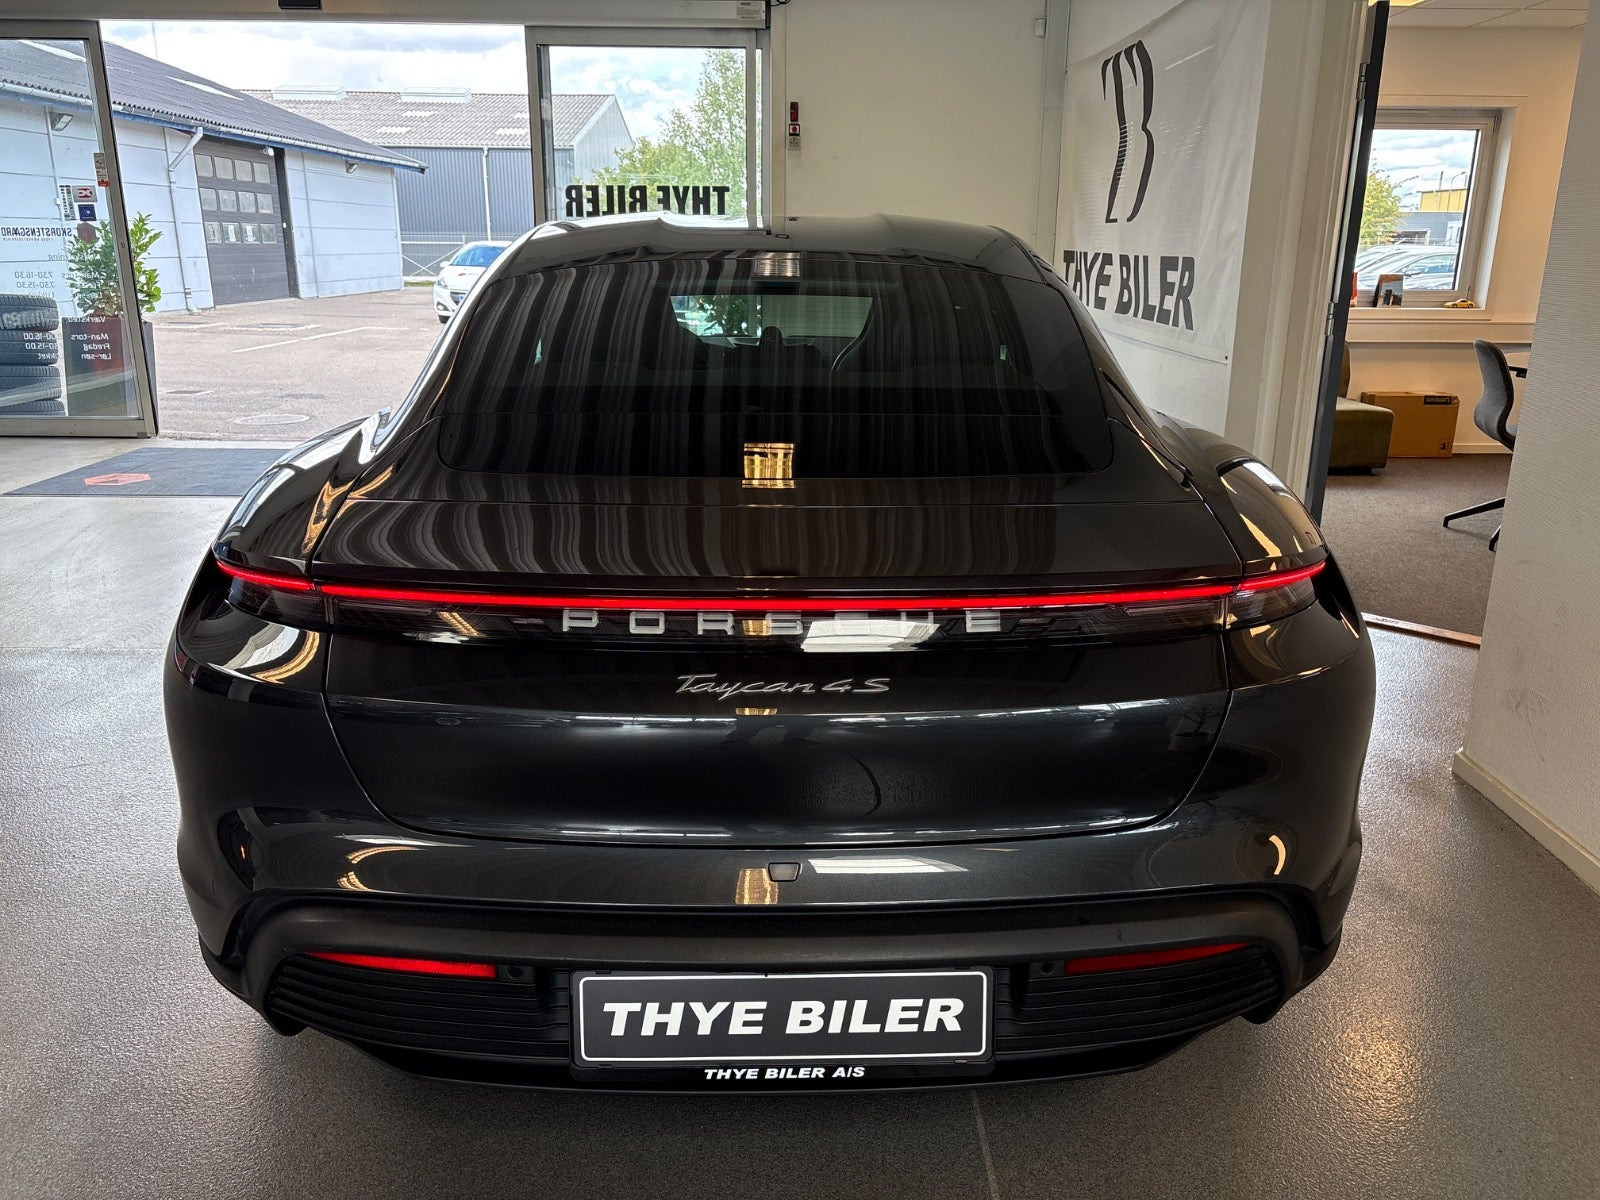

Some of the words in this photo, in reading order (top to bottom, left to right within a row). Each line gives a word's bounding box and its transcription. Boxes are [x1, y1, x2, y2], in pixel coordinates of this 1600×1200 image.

[1063, 250, 1113, 311] THYE
[1115, 254, 1195, 331] BILER
[675, 673, 816, 700] Taycan
[821, 678, 890, 692] 4S
[603, 1001, 767, 1036] THYE
[785, 998, 965, 1034] BILER
[704, 1068, 758, 1080] THYE
[764, 1067, 826, 1079] BILER
